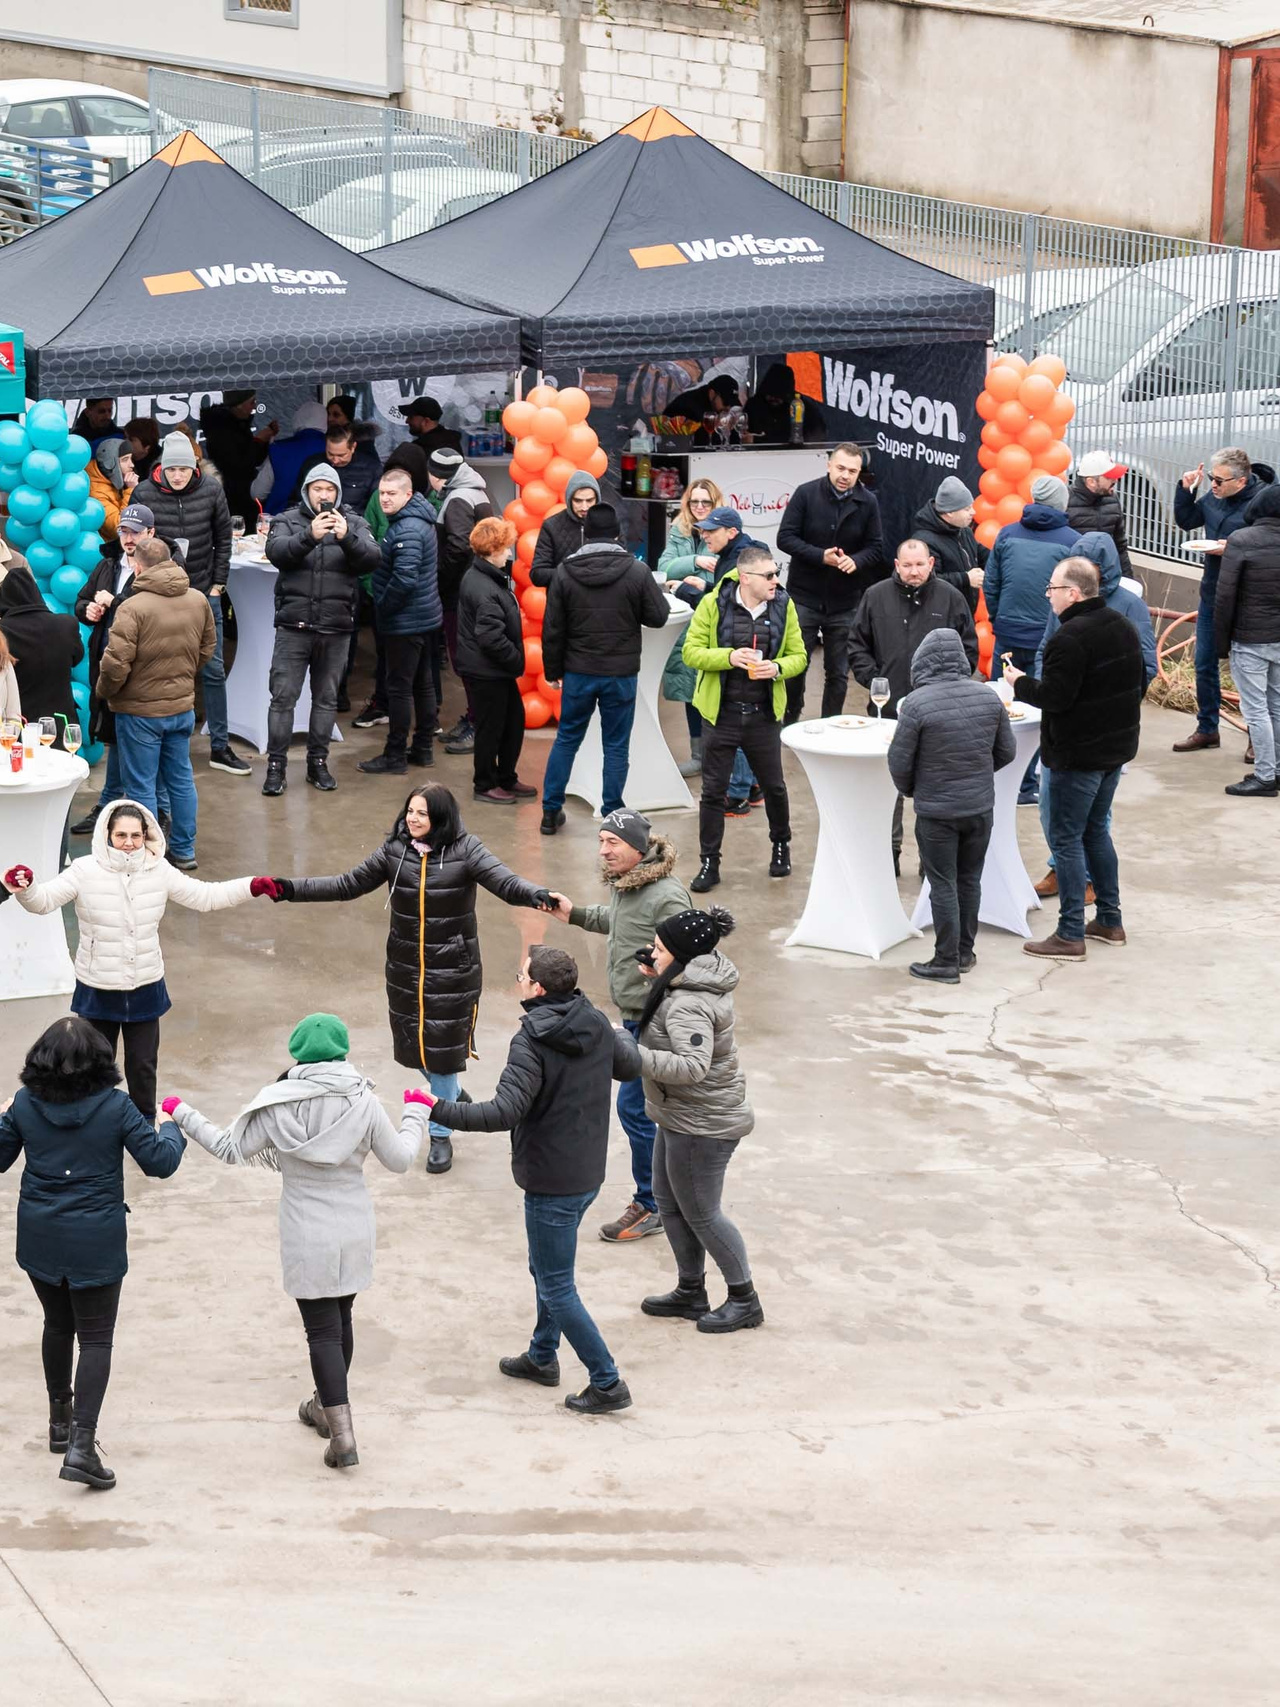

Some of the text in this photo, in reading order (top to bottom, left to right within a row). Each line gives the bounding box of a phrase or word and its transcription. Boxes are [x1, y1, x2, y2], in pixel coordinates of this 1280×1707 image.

[753, 254, 825, 266] Super Power
[271, 285, 347, 296] Super Power
[876, 432, 961, 469] Super Power
